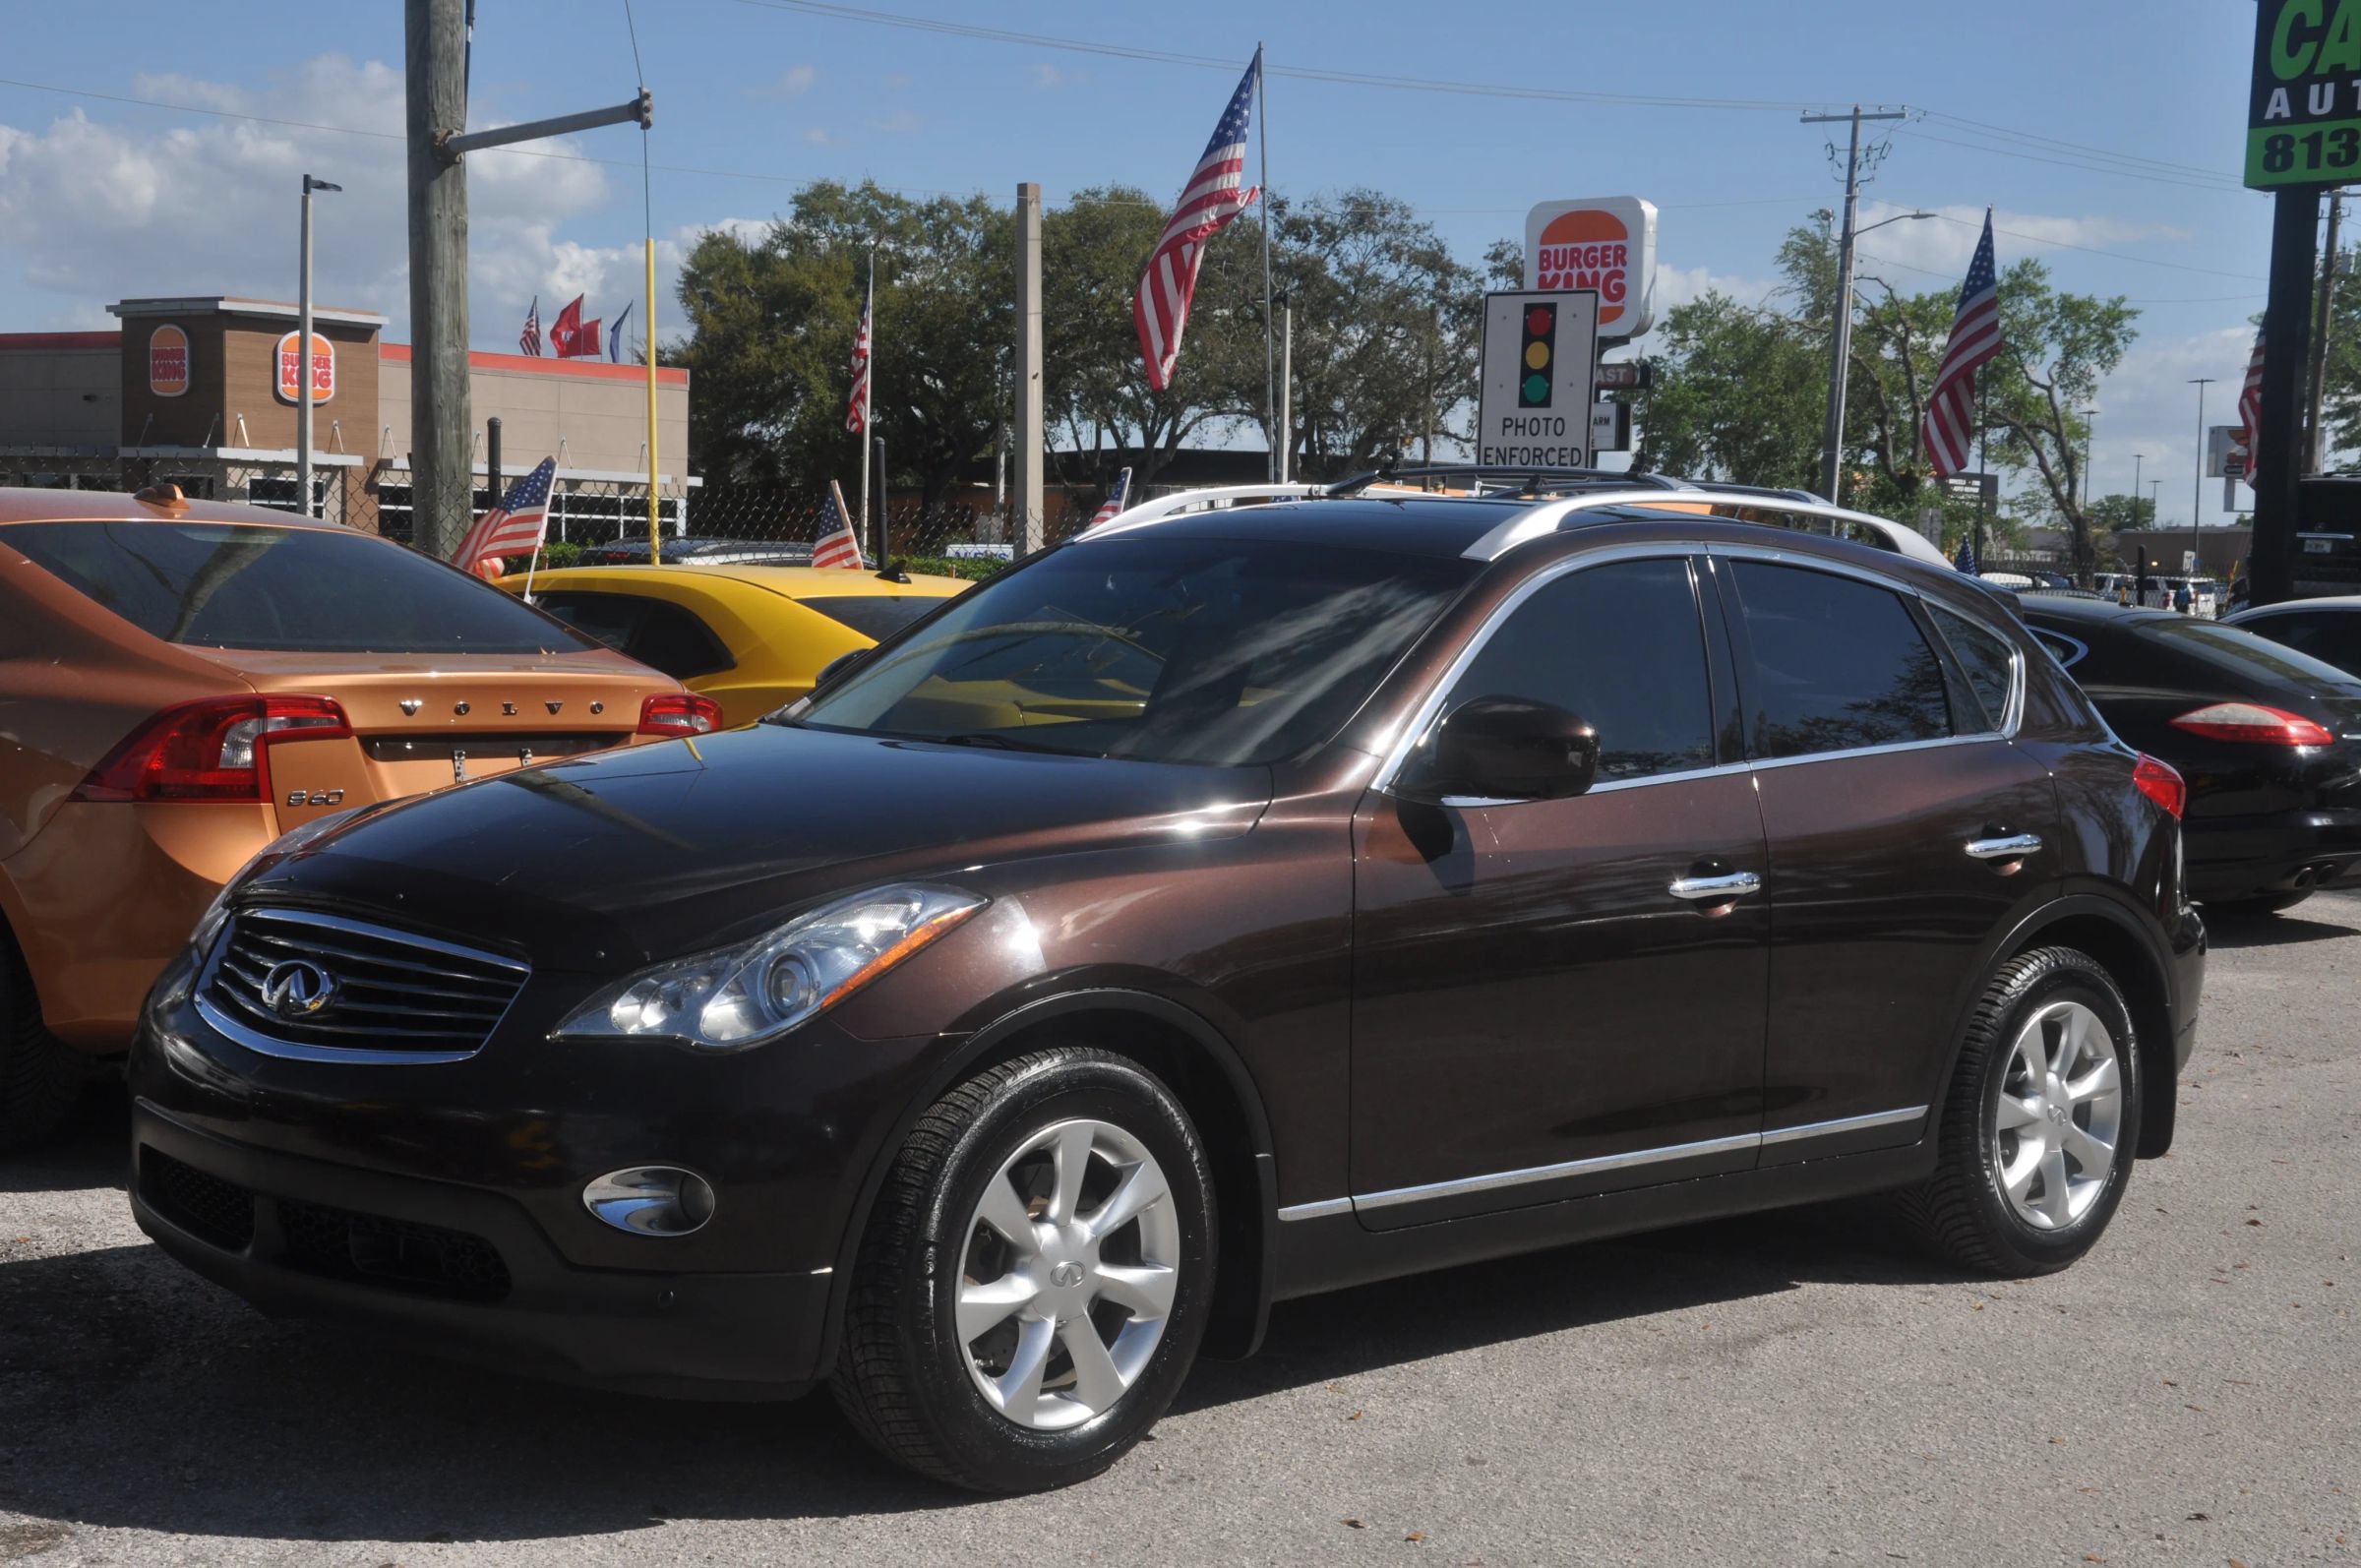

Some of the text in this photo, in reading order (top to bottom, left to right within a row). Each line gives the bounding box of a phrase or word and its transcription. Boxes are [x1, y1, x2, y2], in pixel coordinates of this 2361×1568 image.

[1539, 244, 1627, 271] BURGER
[152, 361, 185, 381] KING
[282, 353, 332, 370] BUER
[282, 367, 332, 389] KG
[1501, 417, 1565, 437] PHOTO
[1483, 446, 1582, 467] ENFORCED
[399, 699, 603, 717] VOLVO
[288, 789, 343, 806] S60
